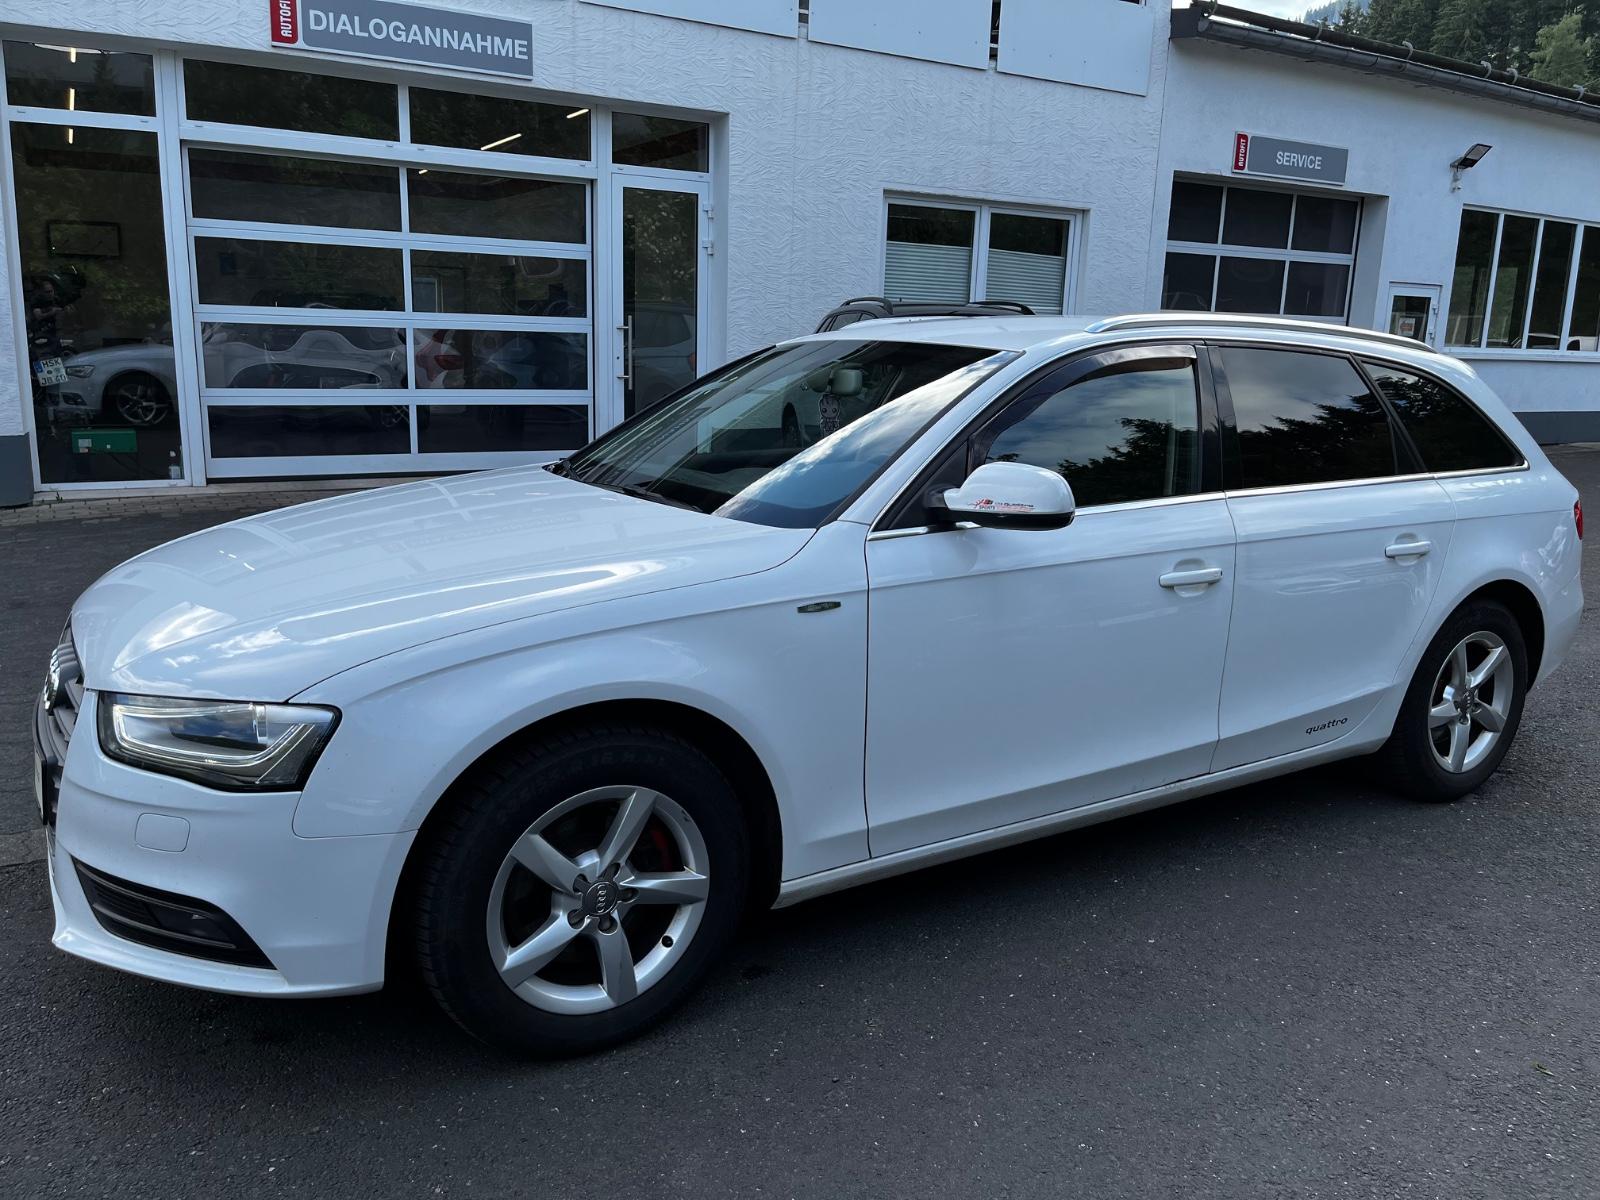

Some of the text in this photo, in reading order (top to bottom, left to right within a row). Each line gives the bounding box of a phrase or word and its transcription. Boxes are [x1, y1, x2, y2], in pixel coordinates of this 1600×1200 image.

[309, 9, 529, 60] DIALOGANNAHME
[1238, 138, 1246, 167] AUTOFIT
[1275, 151, 1322, 170] SERVICE
[1306, 717, 1348, 735] quattro
